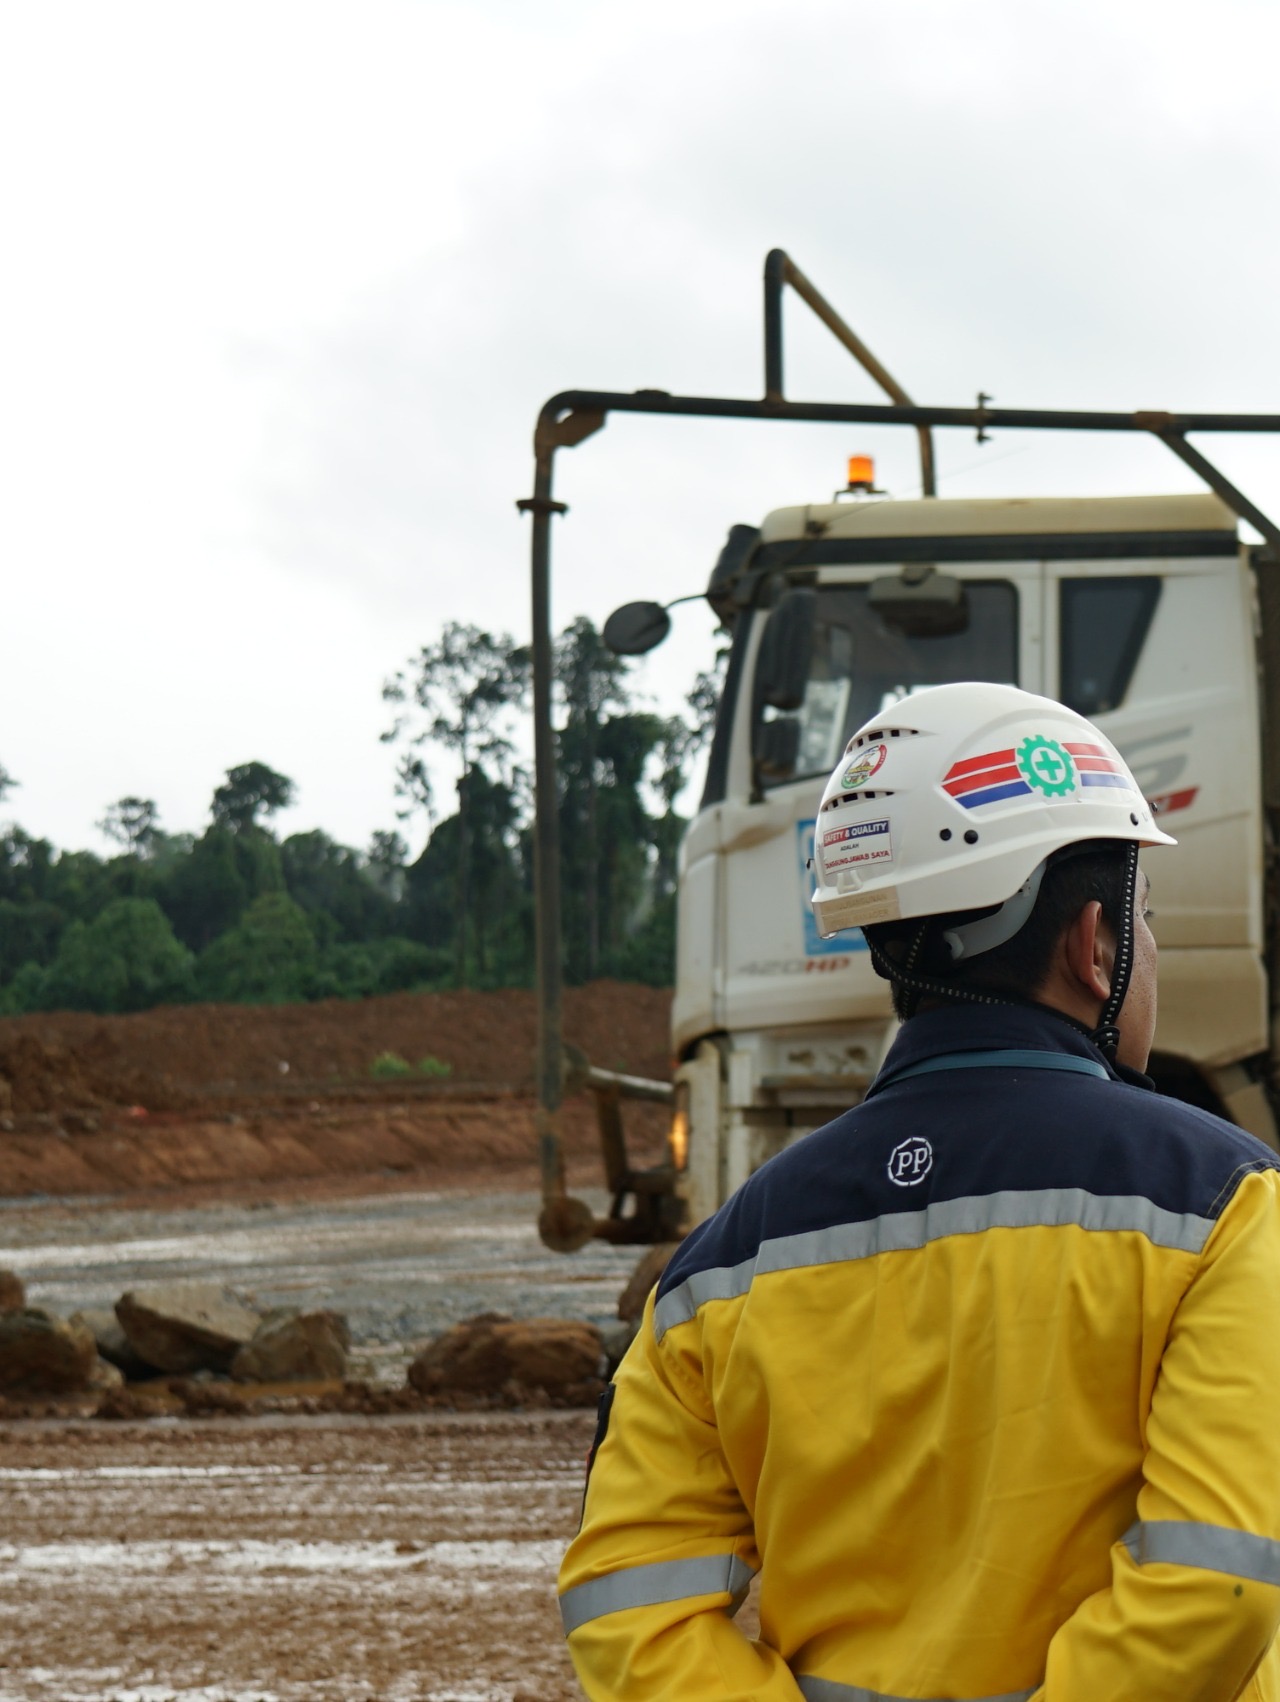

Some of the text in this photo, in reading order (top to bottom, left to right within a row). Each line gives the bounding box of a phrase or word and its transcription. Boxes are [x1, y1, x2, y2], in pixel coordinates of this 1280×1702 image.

[824, 831, 844, 842] SAFETY
[851, 822, 887, 836] QUALITY
[871, 850, 890, 859] SAYA
[896, 1147, 927, 1176] PP
